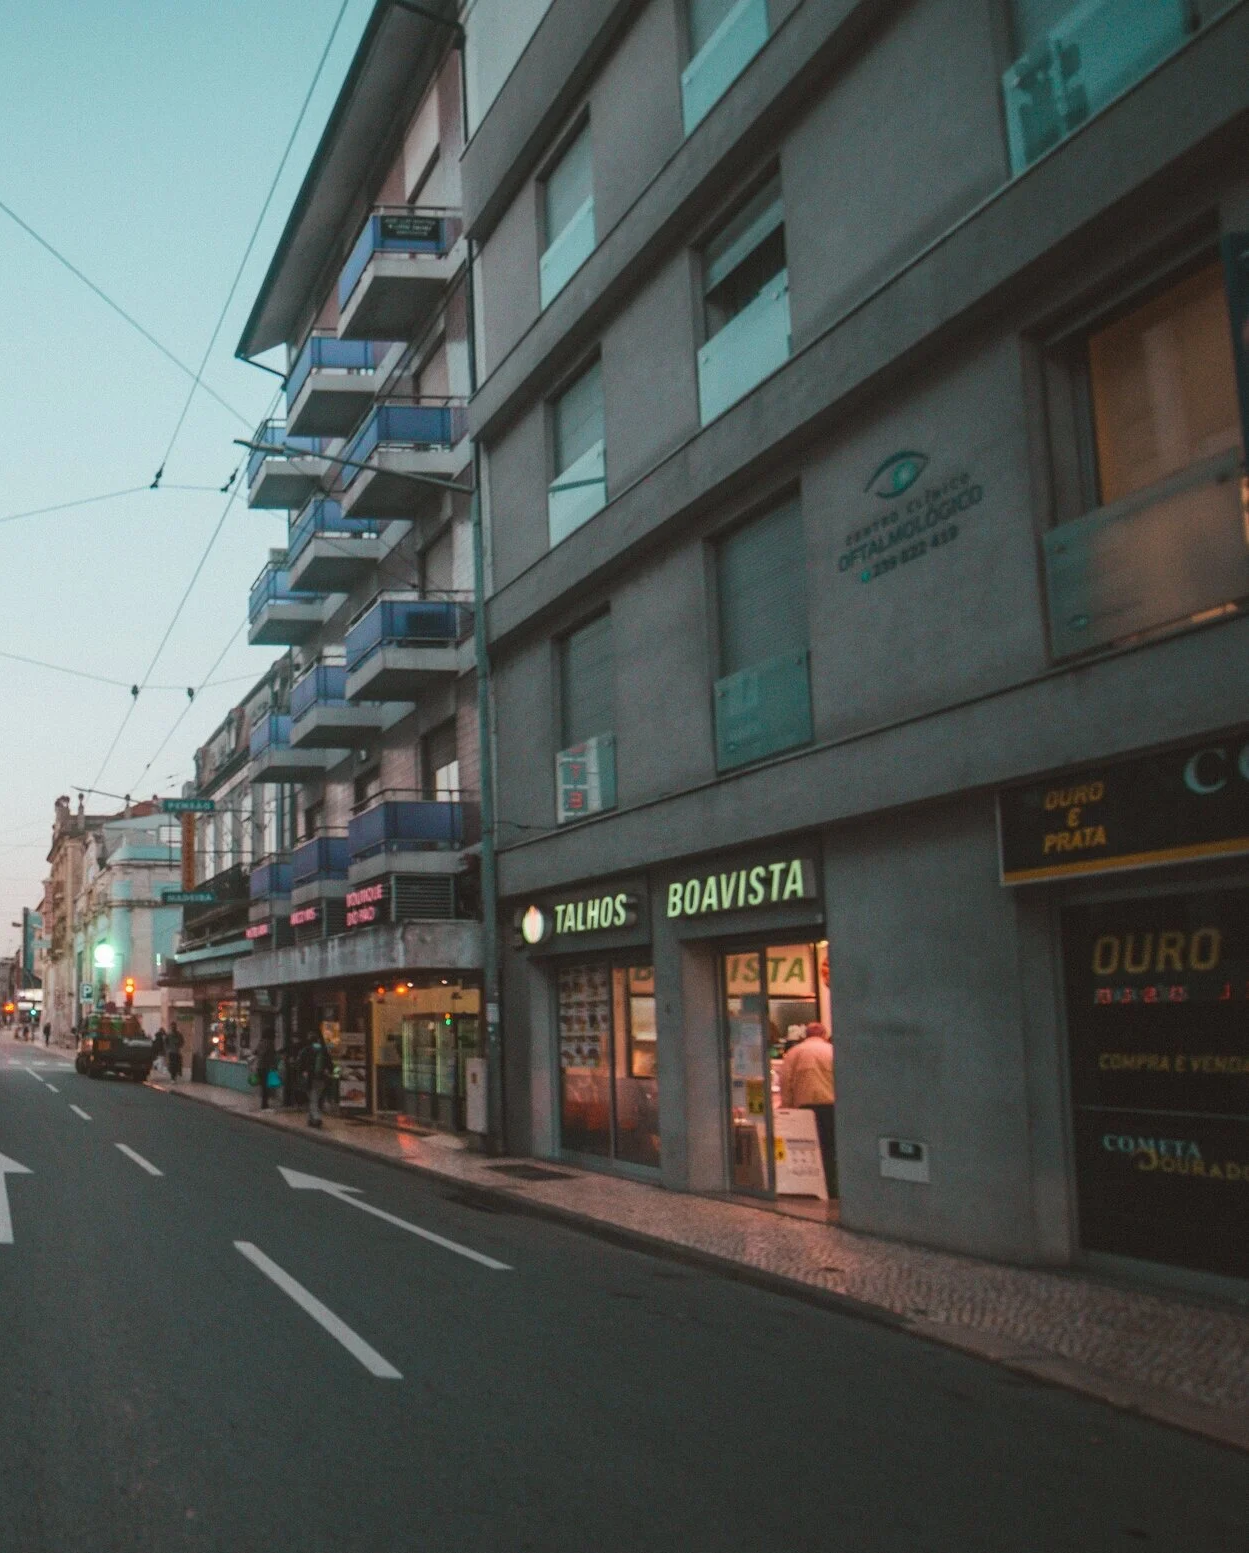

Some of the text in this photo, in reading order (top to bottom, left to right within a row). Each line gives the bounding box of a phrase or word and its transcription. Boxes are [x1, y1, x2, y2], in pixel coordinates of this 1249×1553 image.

[1183, 745, 1249, 795] C
[1045, 781, 1105, 811] OURO
[1067, 806, 1081, 828] E
[1042, 825, 1107, 855] PRATA
[554, 859, 805, 934] TALHOS BOAVISTA
[1092, 927, 1222, 975] OURO
[1099, 1053, 1170, 1072] COMPRA
[1175, 1055, 1187, 1072] E
